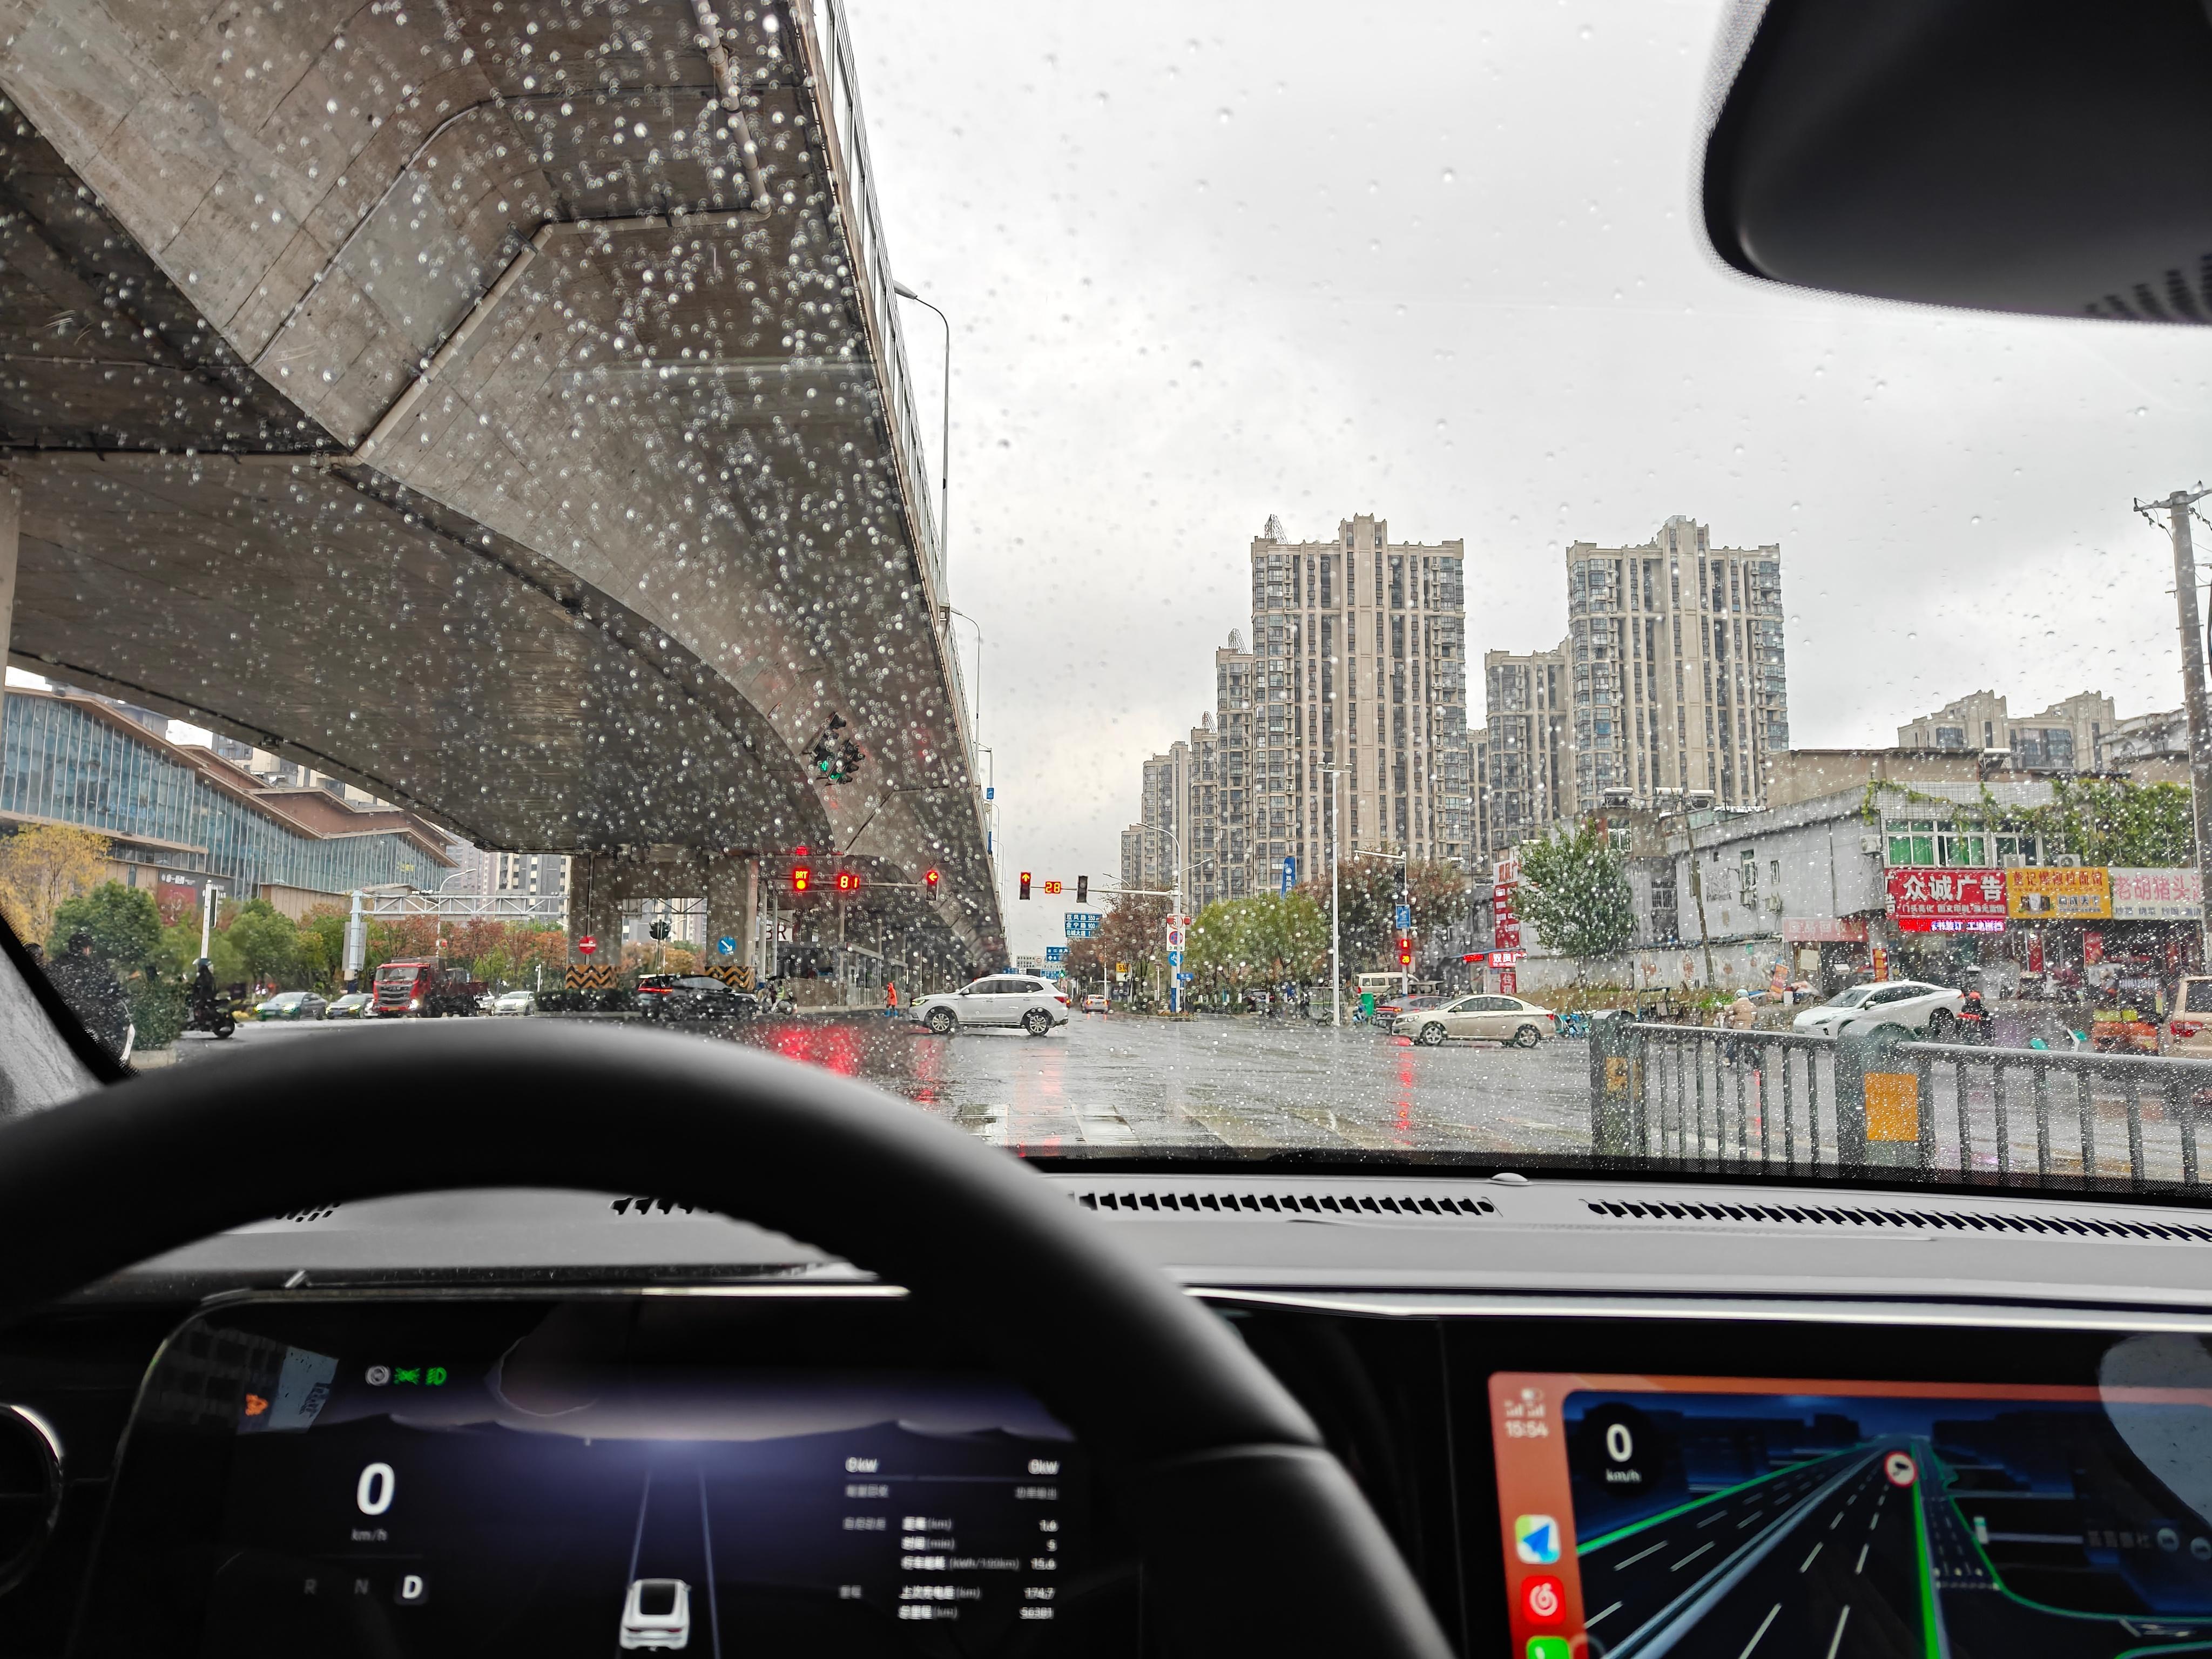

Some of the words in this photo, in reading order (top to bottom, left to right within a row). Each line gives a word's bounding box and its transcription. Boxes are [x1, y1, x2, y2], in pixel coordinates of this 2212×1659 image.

[795, 871, 808, 879] BRT
[840, 875, 858, 888] 81
[1046, 882, 1060, 893] 28
[1903, 875, 2003, 901] 众诚广告
[1505, 1420, 1549, 1438] 15:54
[1607, 1424, 1633, 1462] 0
[1606, 1468, 1641, 1482] km/h
[357, 1462, 395, 1515] 0
[351, 1528, 389, 1541] km/h
[304, 1579, 317, 1594] R
[354, 1579, 369, 1594] N
[402, 1575, 423, 1599] D
